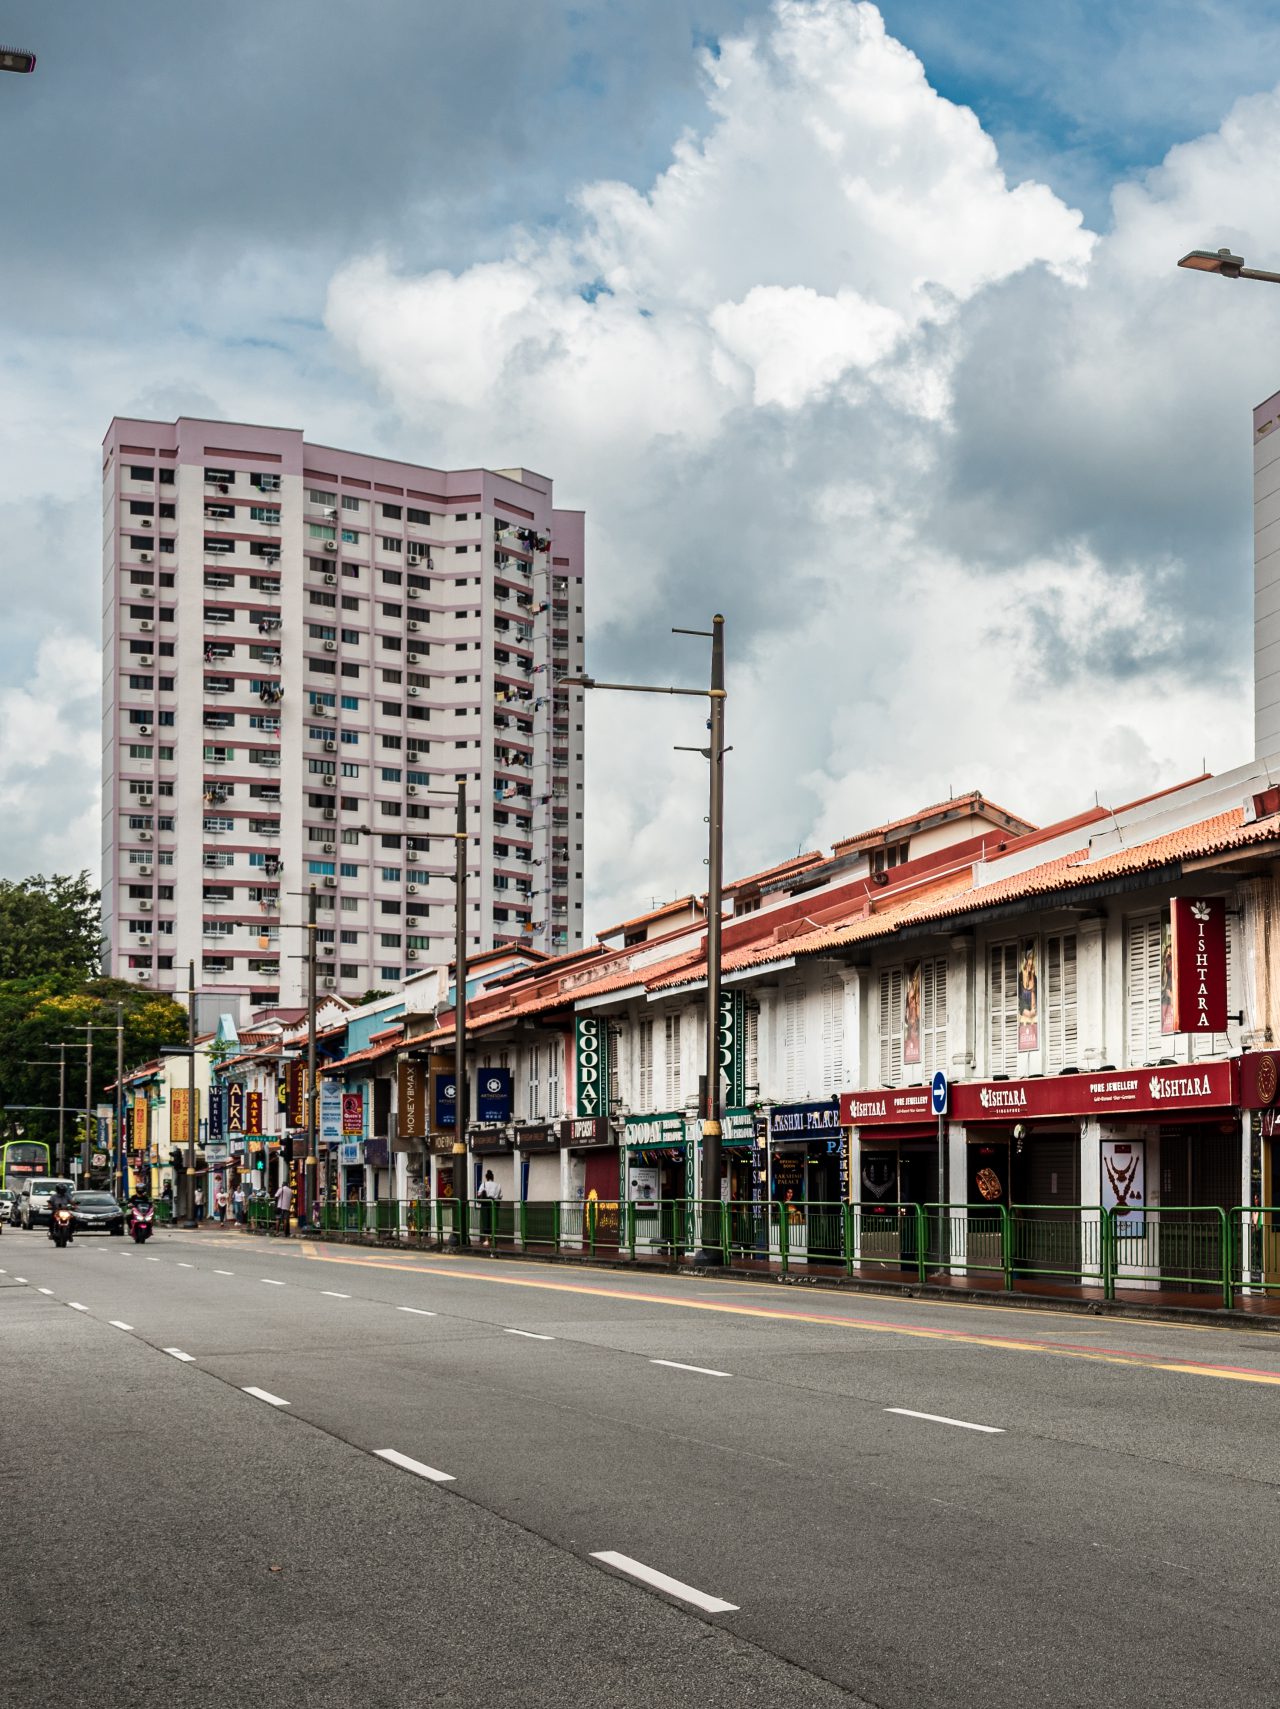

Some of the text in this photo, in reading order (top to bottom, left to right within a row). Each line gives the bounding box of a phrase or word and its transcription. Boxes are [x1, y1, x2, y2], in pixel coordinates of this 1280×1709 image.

[1196, 923, 1209, 1027] ISHTARA
[579, 1019, 598, 1115] GOODAY
[1090, 1080, 1138, 1093] PURE JEWELLERY
[1160, 1074, 1211, 1098] ISHTARA
[230, 1084, 241, 1129] ALKA
[856, 1100, 887, 1117] ISHTARA
[893, 1096, 928, 1106] PURE JEWELLERY
[987, 1088, 1027, 1107] ISHTARA
[807, 1110, 840, 1130] PALACE
[626, 1121, 663, 1145] GOODAY
